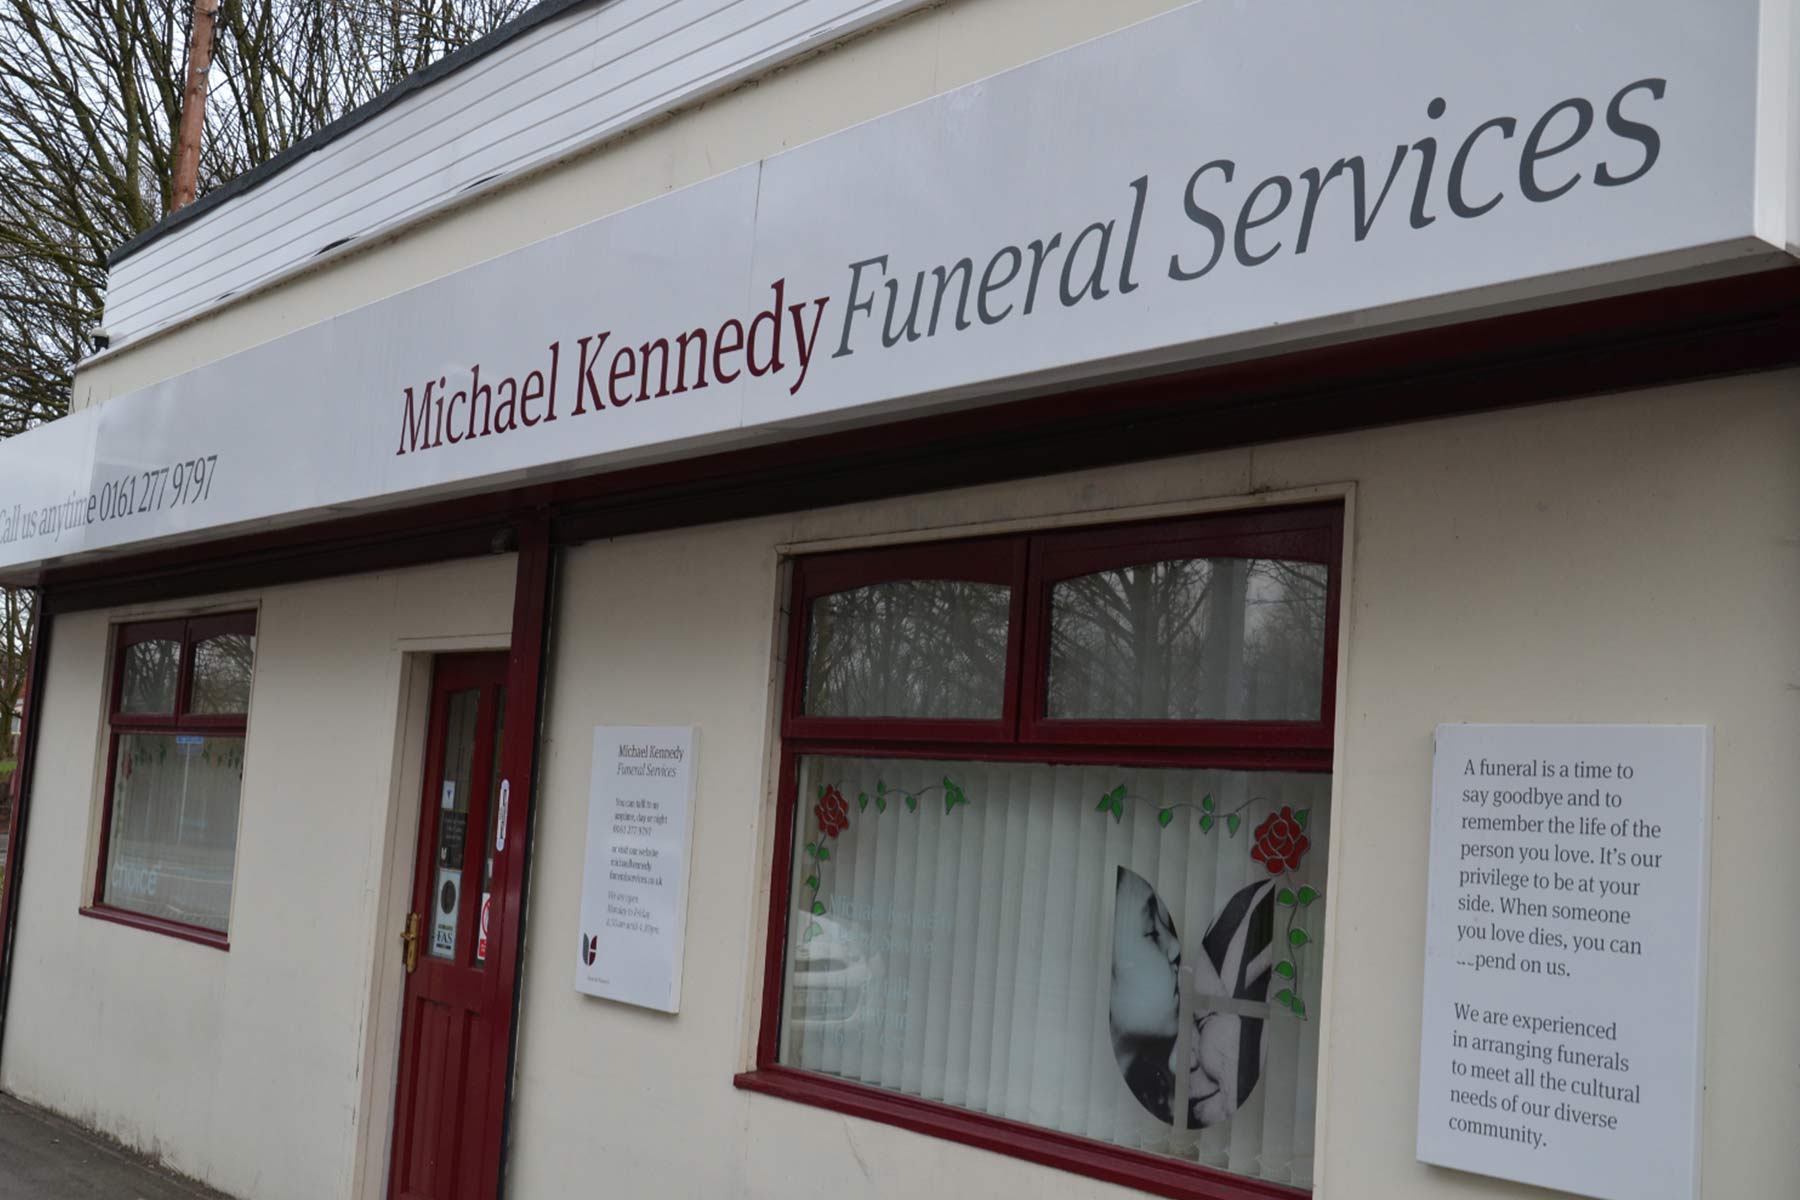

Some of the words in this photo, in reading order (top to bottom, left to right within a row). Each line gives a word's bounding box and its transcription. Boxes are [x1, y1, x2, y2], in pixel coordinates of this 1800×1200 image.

[396, 341, 559, 456] Michael
[571, 278, 830, 396] Kennedy
[832, 175, 1148, 358] Funeral
[1168, 78, 1667, 281] Services
[22, 510, 38, 540] us
[39, 490, 96, 542] anytime
[100, 476, 136, 521] 0161
[138, 467, 169, 513] 277
[171, 455, 218, 509] 9797
[619, 744, 649, 759] Michael
[650, 745, 684, 762] Kennedy
[617, 762, 646, 776] Funeral
[646, 763, 677, 778] Services
[1464, 759, 1475, 775] A
[1480, 758, 1537, 777] funeral
[1542, 760, 1555, 778] is
[1559, 765, 1569, 778] a
[1574, 761, 1612, 779] time
[1617, 763, 1633, 779] to
[1462, 789, 1490, 807] say
[1492, 786, 1563, 810] goodbye
[1567, 789, 1600, 807] and
[1605, 792, 1622, 808] to
[1462, 814, 1544, 833] remember
[1547, 816, 1575, 835] the
[1579, 816, 1606, 836] life
[1610, 818, 1629, 837] of
[1633, 819, 1661, 839] the
[1461, 843, 1514, 860] person
[1518, 847, 1549, 864] you
[1554, 844, 1594, 864] love.
[1600, 847, 1626, 866] It’s
[1631, 853, 1662, 868] our
[1460, 868, 1529, 891] privilege
[1533, 873, 1550, 890] to
[1554, 872, 1574, 891] be
[1578, 876, 1595, 893] at
[1599, 880, 1640, 898] your
[1458, 894, 1494, 913] side.
[1500, 896, 1548, 918] When
[1552, 905, 1631, 924] someone
[1457, 925, 1487, 941] you
[1491, 923, 1525, 944] love
[1529, 927, 1567, 951] dies,
[1572, 936, 1605, 953] you
[1610, 939, 1641, 955] can
[1520, 959, 1541, 973] on
[1547, 961, 1570, 976] us.
[1454, 1002, 1479, 1022] We
[1483, 1011, 1508, 1026] are
[1512, 1014, 1616, 1044] experienced
[1453, 1030, 1467, 1048] in
[1472, 1037, 1553, 1065] arranging
[1557, 1044, 1629, 1072] funerals
[1452, 1059, 1467, 1076] to
[1470, 1065, 1510, 1083] meet
[1514, 1068, 1534, 1087] all
[1540, 1071, 1567, 1092] the
[1571, 1078, 1640, 1103] cultural
[1451, 1089, 1497, 1109] needs
[1501, 1094, 1519, 1112] of
[1521, 1101, 1550, 1118] our
[1554, 1102, 1617, 1130] diverse
[1449, 1117, 1547, 1149] community.
